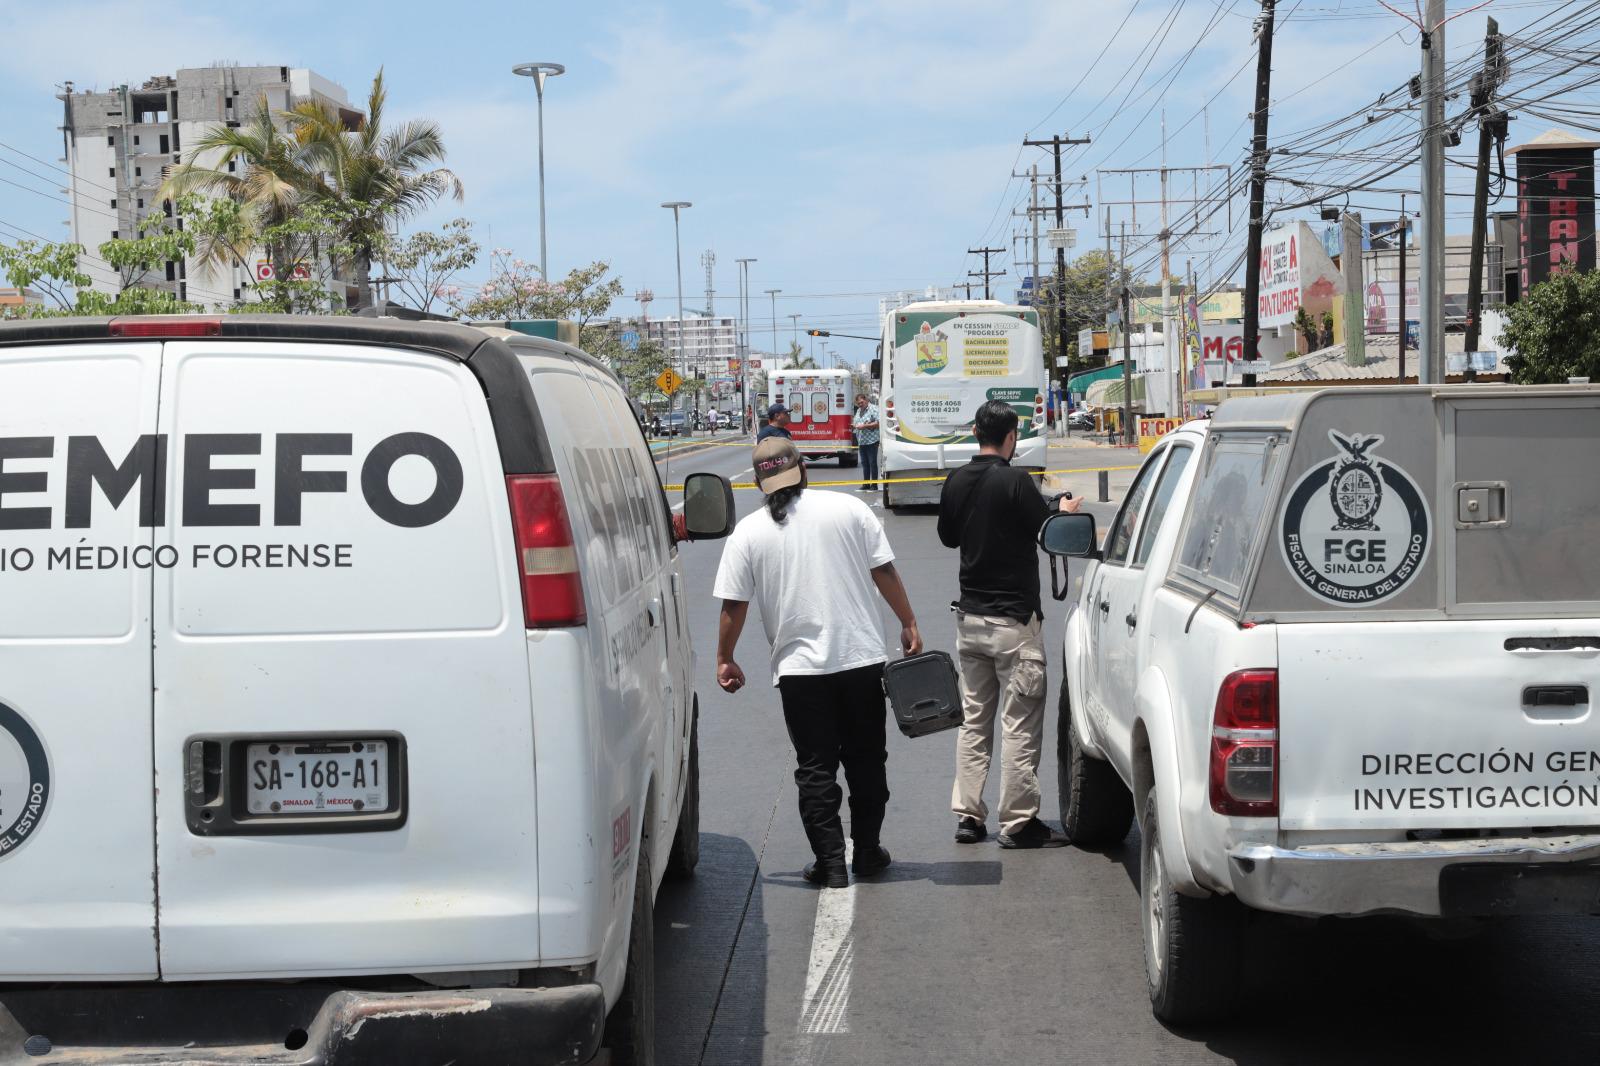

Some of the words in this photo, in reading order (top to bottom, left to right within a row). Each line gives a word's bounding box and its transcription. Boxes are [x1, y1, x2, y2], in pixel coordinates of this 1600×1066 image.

[1260, 287, 1299, 318] PINTURAS
[47, 537, 179, 570] MÉDICO
[193, 543, 353, 568] FORENSE
[1288, 532, 1316, 585] FISCALÍA
[1317, 580, 1374, 600] GENERAL
[1374, 578, 1400, 596] DEL
[1396, 533, 1424, 581] ESTADO
[1324, 538, 1387, 563] FGE
[1323, 562, 1386, 575] SINALOA
[253, 758, 379, 791] SA-168-A1
[1361, 747, 1534, 776] DIRECCIÓN
[15, 782, 44, 836] ESTADO
[1354, 779, 1598, 811] INVESTIGACIÓN
